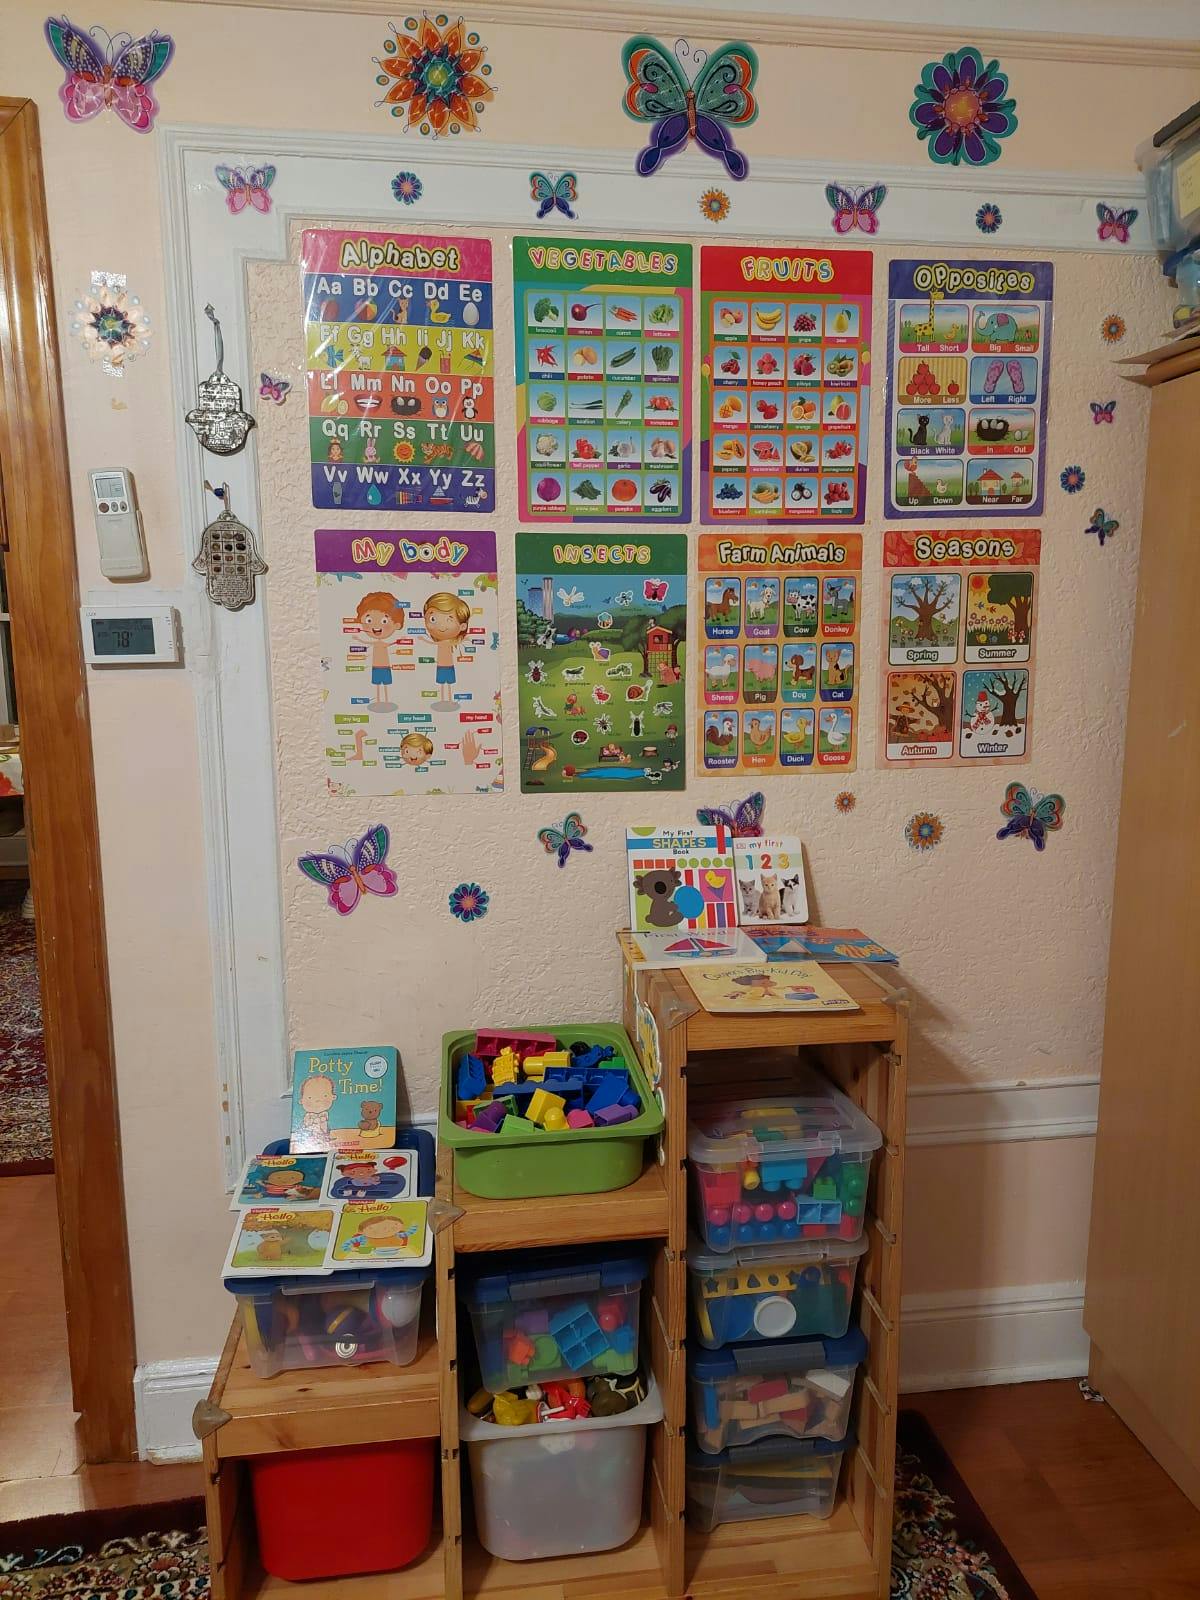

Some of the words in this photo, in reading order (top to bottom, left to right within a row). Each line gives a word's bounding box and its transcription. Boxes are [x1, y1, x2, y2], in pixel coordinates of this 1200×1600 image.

[342, 240, 459, 270] Alphabet
[529, 246, 678, 275] VEGETABLES
[741, 256, 834, 283] FRUITS
[317, 277, 342, 295] Aa
[353, 279, 379, 296] Bb
[388, 280, 413, 298] Cc
[424, 282, 449, 300] Dd
[459, 284, 483, 302] Ee
[320, 325, 340, 342] Ff
[347, 326, 374, 348] Gg
[381, 328, 408, 345] Hh
[417, 329, 428, 346] Ii
[437, 330, 453, 352] Jj
[462, 332, 485, 349] Kk
[916, 344, 930, 352] Tall
[989, 344, 1001, 353] Big
[351, 374, 382, 391] Mm
[391, 375, 415, 392] Nn
[425, 376, 452, 395] Oo
[461, 379, 483, 399] Pp
[1008, 396, 1027, 405] Right
[322, 419, 349, 440] Qq
[360, 420, 382, 438] Rr
[393, 422, 416, 439] Ss
[427, 423, 449, 441] Tt
[460, 425, 484, 442] Uu
[323, 466, 348, 483] Vv
[356, 466, 389, 484] Ww
[398, 468, 421, 485] Xx
[429, 468, 452, 489] Yy
[461, 470, 485, 487] Zz
[908, 497, 919, 505] Up
[352, 537, 395, 567] My
[399, 536, 468, 567] body
[719, 542, 768, 564] Farm
[770, 542, 846, 564] Animals
[915, 536, 1016, 560] Seasons
[553, 544, 651, 564] INSECTS
[712, 627, 734, 635] Horse
[824, 626, 850, 634] Donkey
[906, 649, 939, 662] Spring
[978, 648, 1017, 658] Summer
[711, 694, 734, 702] Sheep
[754, 693, 767, 702] Pig
[792, 691, 806, 700] Dog
[901, 745, 937, 755] Autumn
[977, 743, 1008, 753] Winter
[708, 757, 736, 766] Rooster
[752, 756, 766, 764] Hen
[823, 754, 846, 762] Goose
[652, 836, 707, 849] SHAPES
[749, 841, 762, 849] my
[764, 839, 783, 848] first
[746, 854, 754, 870] 1
[760, 854, 772, 869] 2
[778, 853, 790, 869] 3
[308, 1057, 353, 1076] Potty
[339, 1078, 383, 1095] Time!
[359, 1203, 389, 1212] Hello
[261, 1213, 293, 1221] Hello
